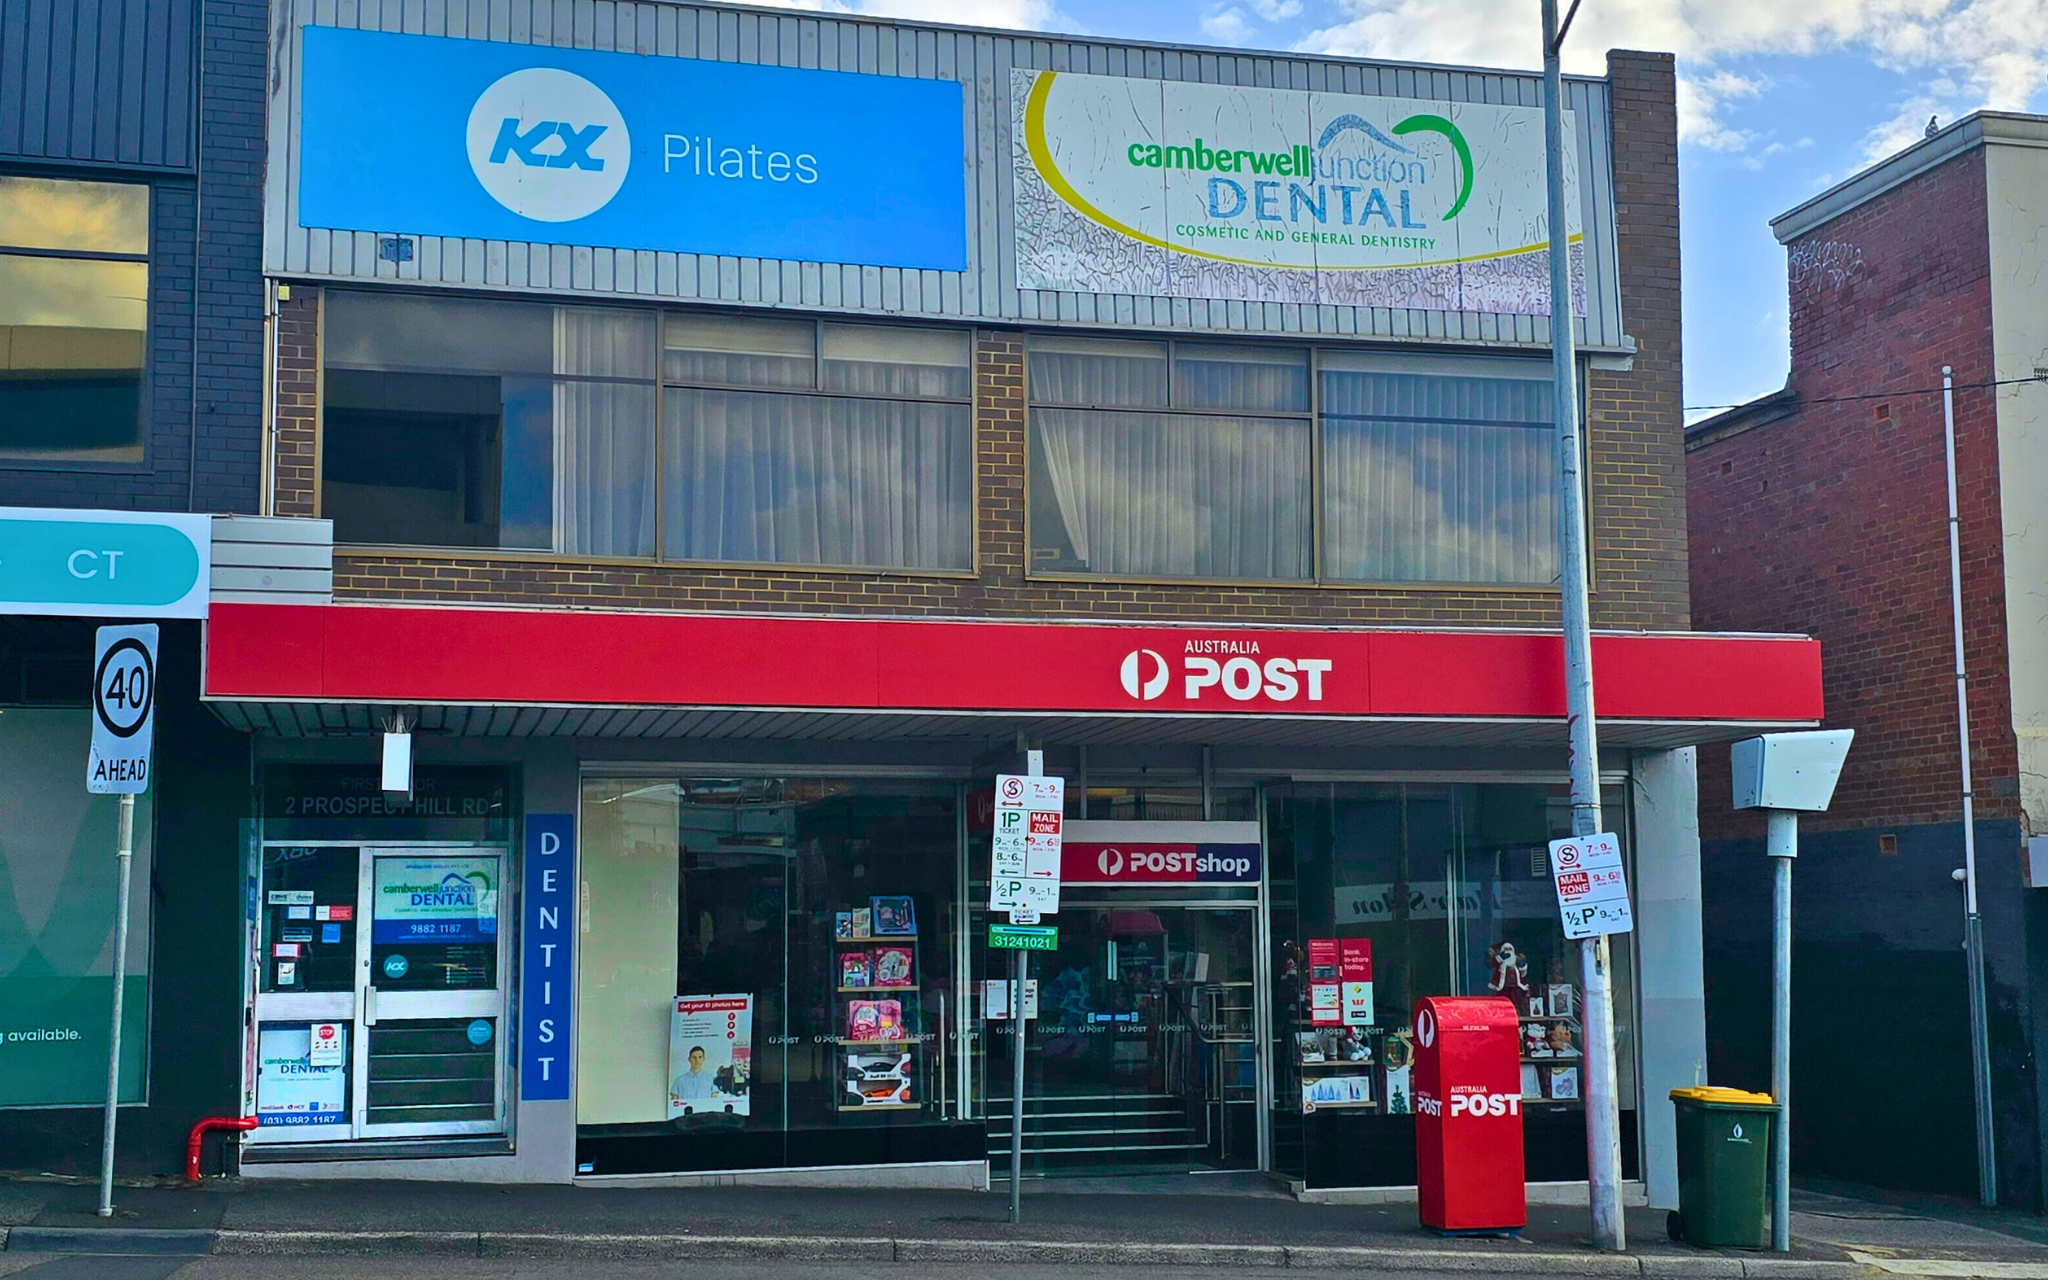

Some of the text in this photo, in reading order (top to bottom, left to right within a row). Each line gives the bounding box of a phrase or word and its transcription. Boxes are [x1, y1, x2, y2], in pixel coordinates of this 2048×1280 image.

[489, 117, 609, 172] KX
[664, 133, 819, 184] Pilates
[1127, 138, 1426, 186] camberwell junction
[1207, 177, 1427, 230] DENTAL
[1176, 224, 1437, 250] COSMETIC AND GENERAL DENTISTRY
[67, 548, 125, 580] CT
[1184, 639, 1261, 655] AUSTRALIA
[1184, 656, 1333, 701] POST
[106, 665, 145, 710] 40
[93, 759, 147, 782] AHEAD
[285, 796, 296, 815] 2
[415, 796, 457, 815] HILL
[462, 797, 490, 815] RD
[1001, 811, 1021, 828] 1P
[1032, 812, 1059, 823] MAIL
[1034, 823, 1056, 833] ZONE
[1560, 873, 1587, 885] MAIL
[383, 882, 476, 895] camberwell junction
[1561, 883, 1590, 895] ZONE
[411, 893, 475, 906] DENTAL
[410, 923, 462, 934] 9882 1187
[994, 935, 1051, 949] 31241021
[537, 831, 561, 1082] DENTIST
[711, 1001, 731, 1009] photos
[8, 1028, 82, 1042] available.
[319, 1028, 334, 1037] STOP
[1045, 1026, 1066, 1034] POST
[1086, 1025, 1106, 1033] POST
[1127, 1025, 1148, 1033] POST
[1324, 1028, 1342, 1036] POST
[823, 1035, 845, 1043] POST
[1450, 1085, 1487, 1094] AUSTRALIA
[1417, 1096, 1443, 1117] POST
[1450, 1093, 1522, 1117] POST
[286, 1116, 310, 1124] 9882
[313, 1115, 336, 1124] 1187
